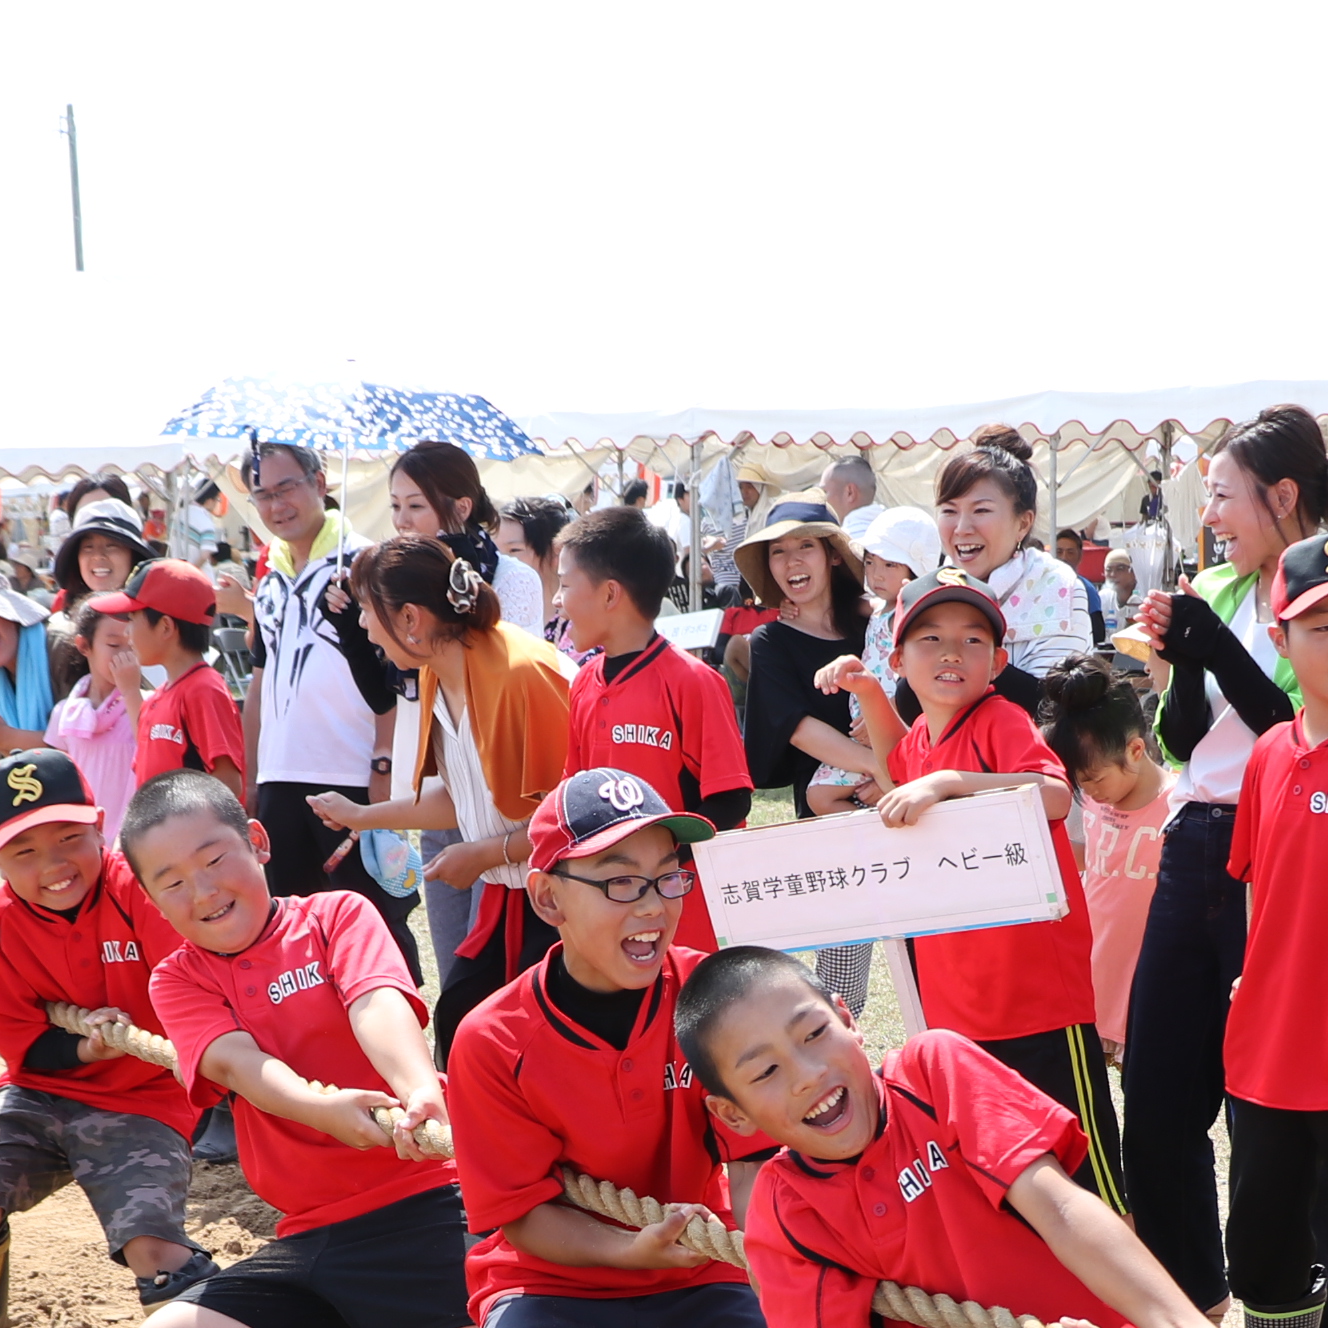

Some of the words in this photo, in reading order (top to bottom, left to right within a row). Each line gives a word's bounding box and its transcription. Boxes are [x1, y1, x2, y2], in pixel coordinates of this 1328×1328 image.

[612, 724, 673, 750] SHIKA
[7, 763, 44, 807] S
[598, 776, 645, 812] W
[721, 856, 911, 905] 志賀学童野球クラブ
[938, 842, 1029, 871] ヘビー級
[267, 960, 325, 1005] SHIK
